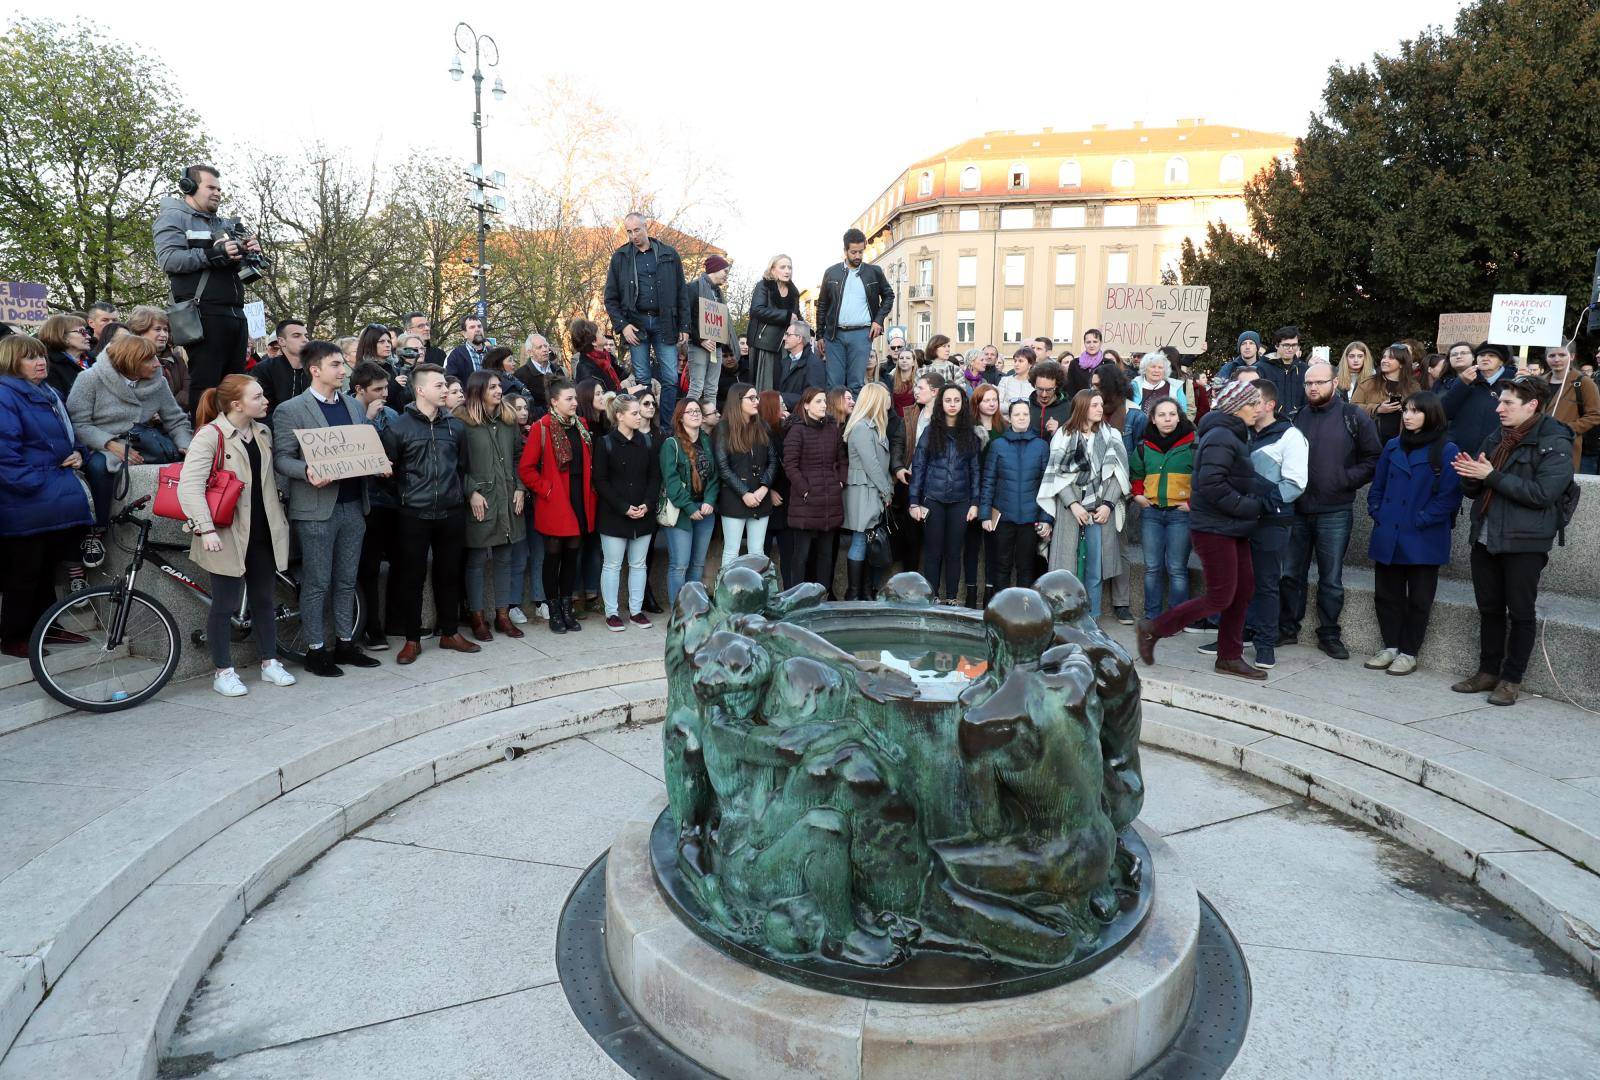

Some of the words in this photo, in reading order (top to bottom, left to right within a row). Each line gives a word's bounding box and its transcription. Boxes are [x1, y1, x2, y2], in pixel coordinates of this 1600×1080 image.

[1106, 287, 1153, 311] BORAS
[1156, 299, 1167, 310] na
[1500, 299, 1552, 308] MARATONCI
[704, 311, 723, 327] KUM
[1103, 319, 1153, 346] BANDIĆ
[1506, 323, 1536, 334] KRUG
[302, 429, 346, 445] OVAJ
[311, 443, 366, 458] KARTON
[311, 460, 354, 478] VRIJEDI
[356, 455, 385, 472] VIŠE
